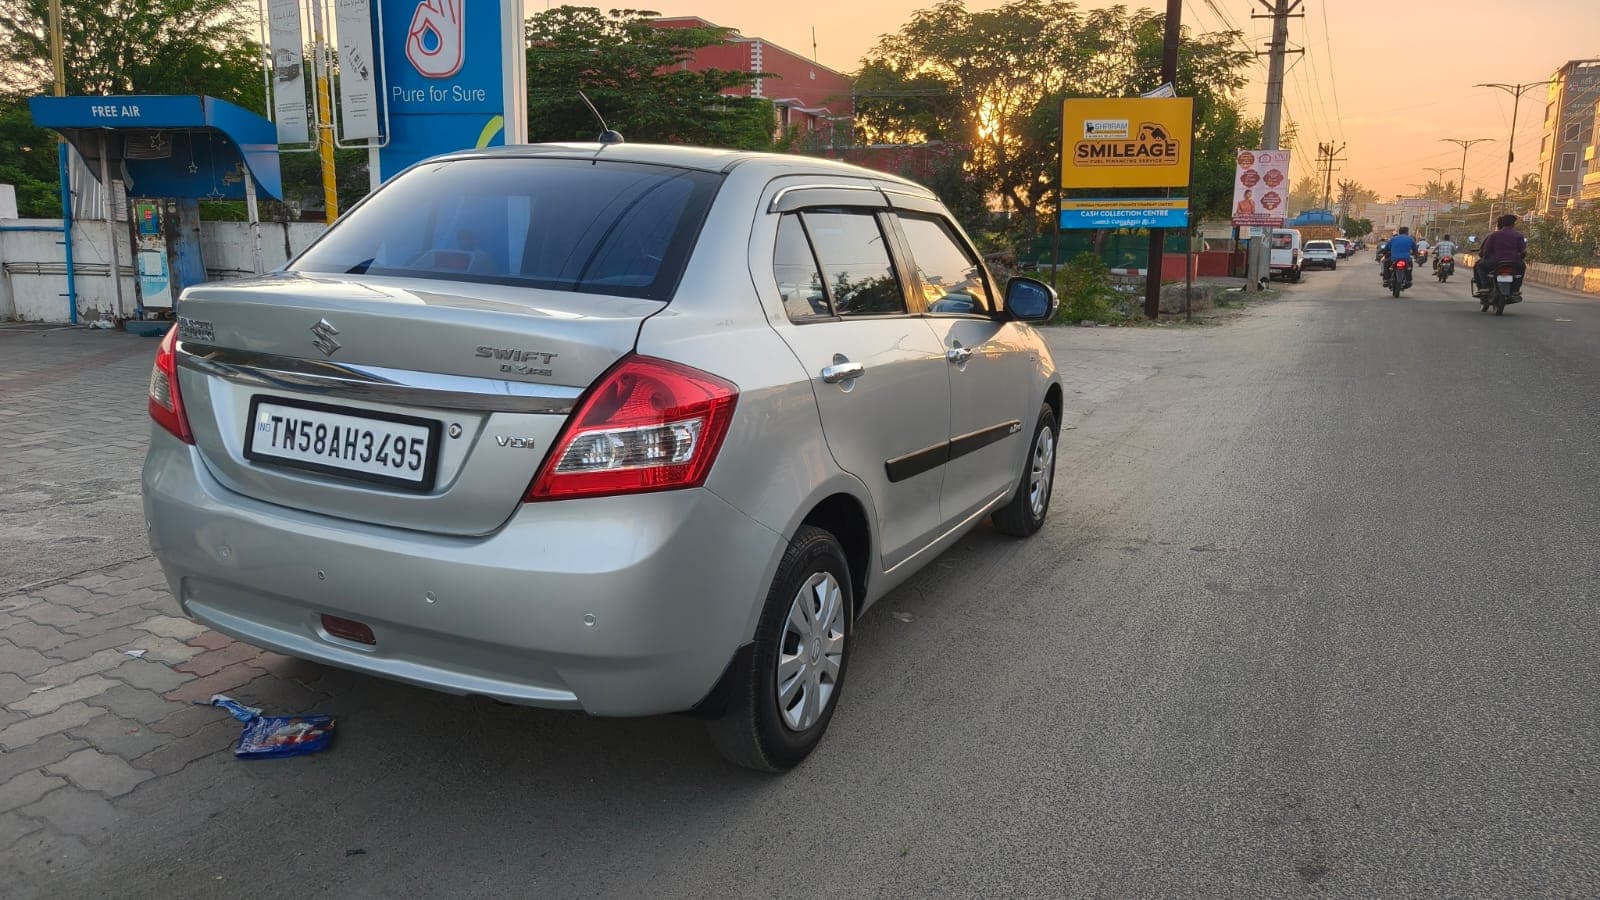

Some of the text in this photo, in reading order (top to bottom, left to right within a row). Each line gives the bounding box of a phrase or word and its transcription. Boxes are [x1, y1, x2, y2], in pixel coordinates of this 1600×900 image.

[392, 85, 486, 102] Pure for Sure
[91, 105, 141, 117] FREE AIR
[1077, 143, 1176, 158] SMILEAGE
[1143, 209, 1169, 217] CENTRE
[475, 346, 559, 364] SWIFT
[257, 415, 425, 471] IND TN58AH3495
